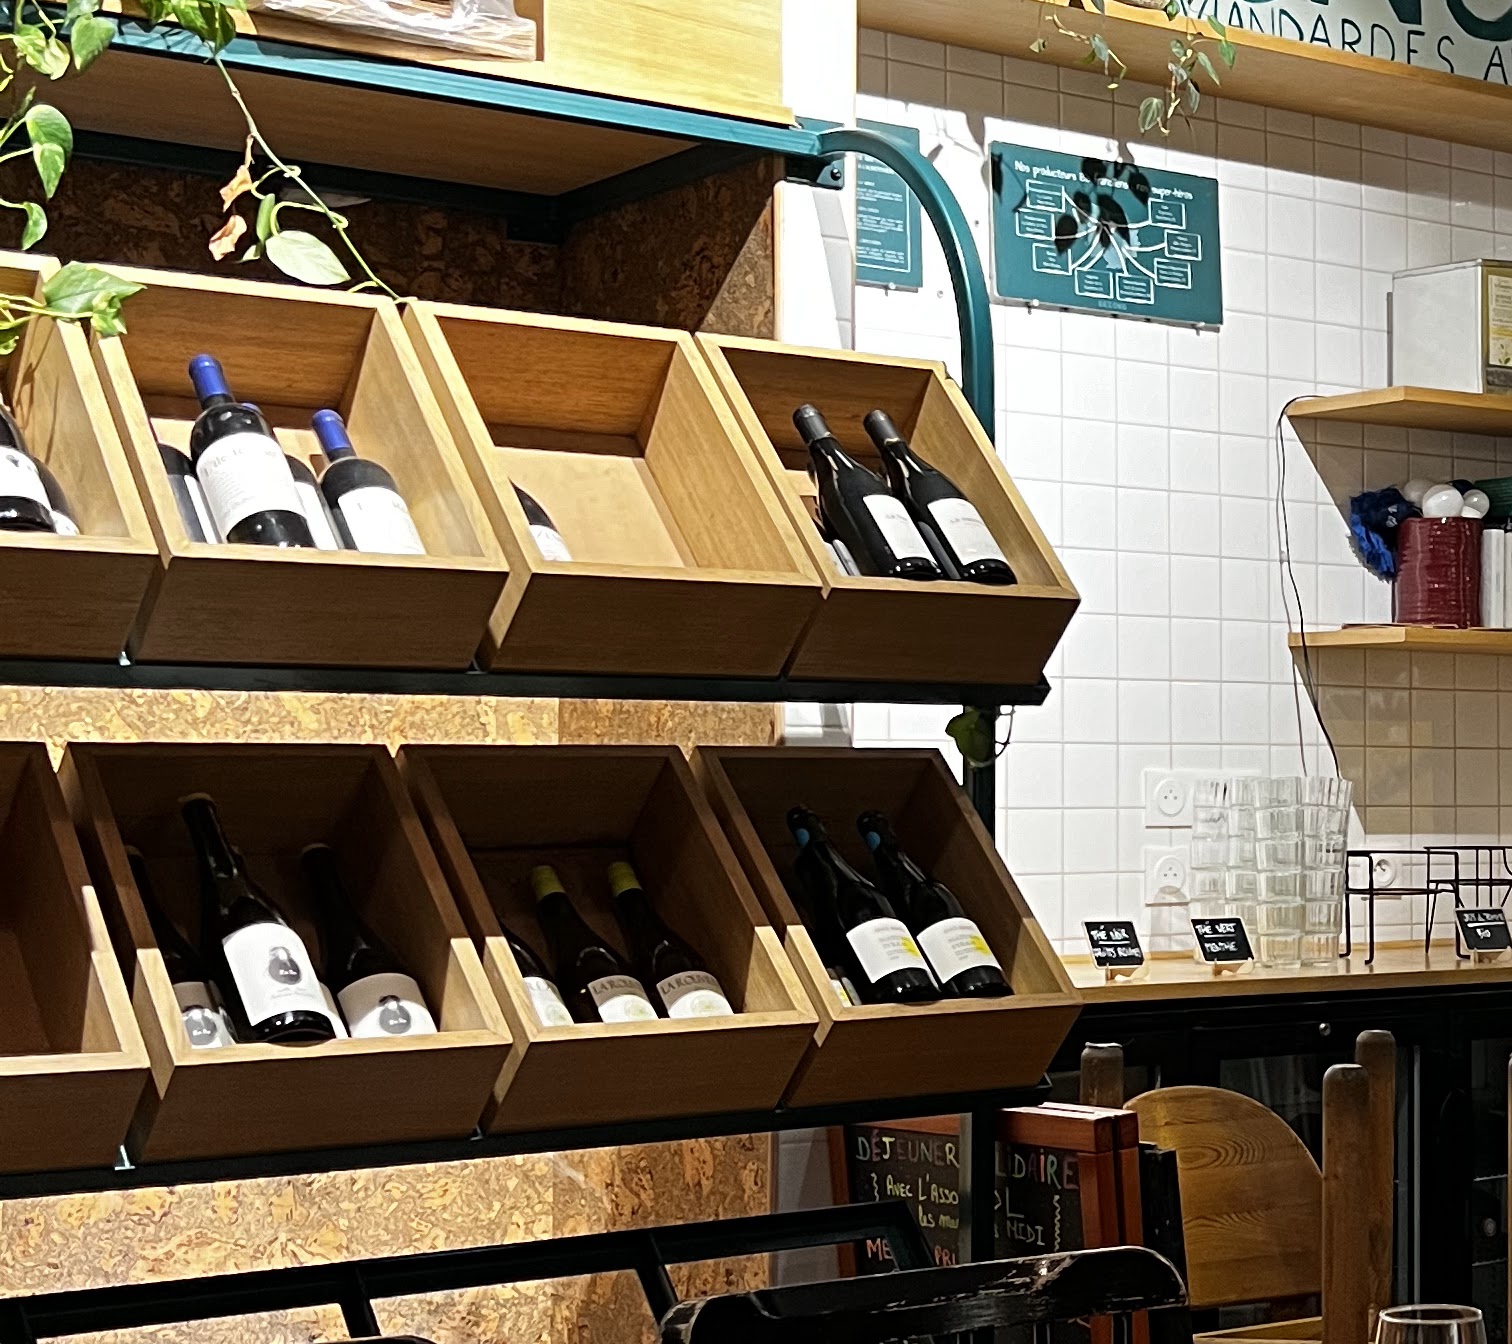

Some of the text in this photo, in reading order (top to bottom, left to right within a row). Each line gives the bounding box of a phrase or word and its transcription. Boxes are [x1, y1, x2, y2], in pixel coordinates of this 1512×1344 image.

[1195, 920, 1237, 935] THÉ VERT
[856, 1129, 961, 1168] DÉJEUNER
[1005, 1220, 1046, 1246] MIDI
